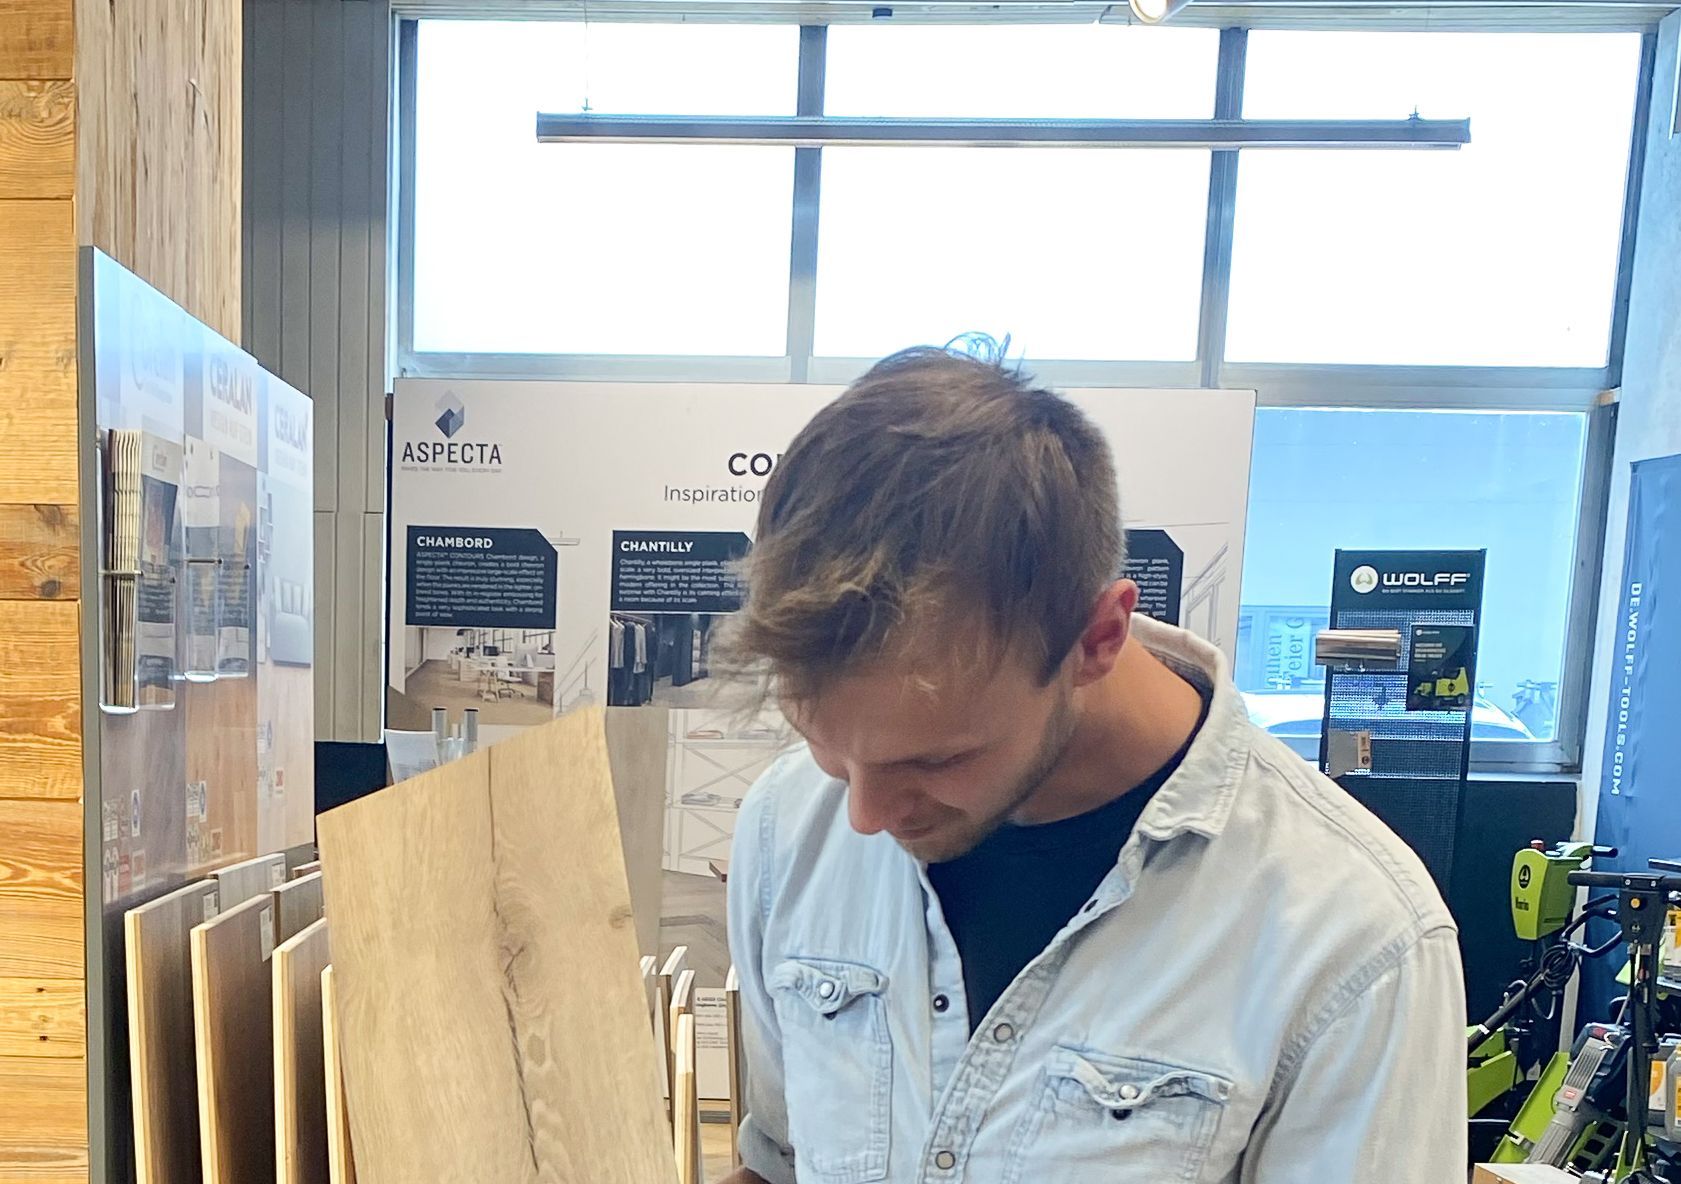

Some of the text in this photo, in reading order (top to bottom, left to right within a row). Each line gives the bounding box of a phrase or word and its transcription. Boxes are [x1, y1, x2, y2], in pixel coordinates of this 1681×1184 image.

[416, 536, 494, 549] CHAMBORD
[620, 540, 694, 553] CHANTILLY
[1382, 572, 1468, 587] WOLFF
[1611, 581, 1643, 796] DE.WOLFF-TOOLS.COM
